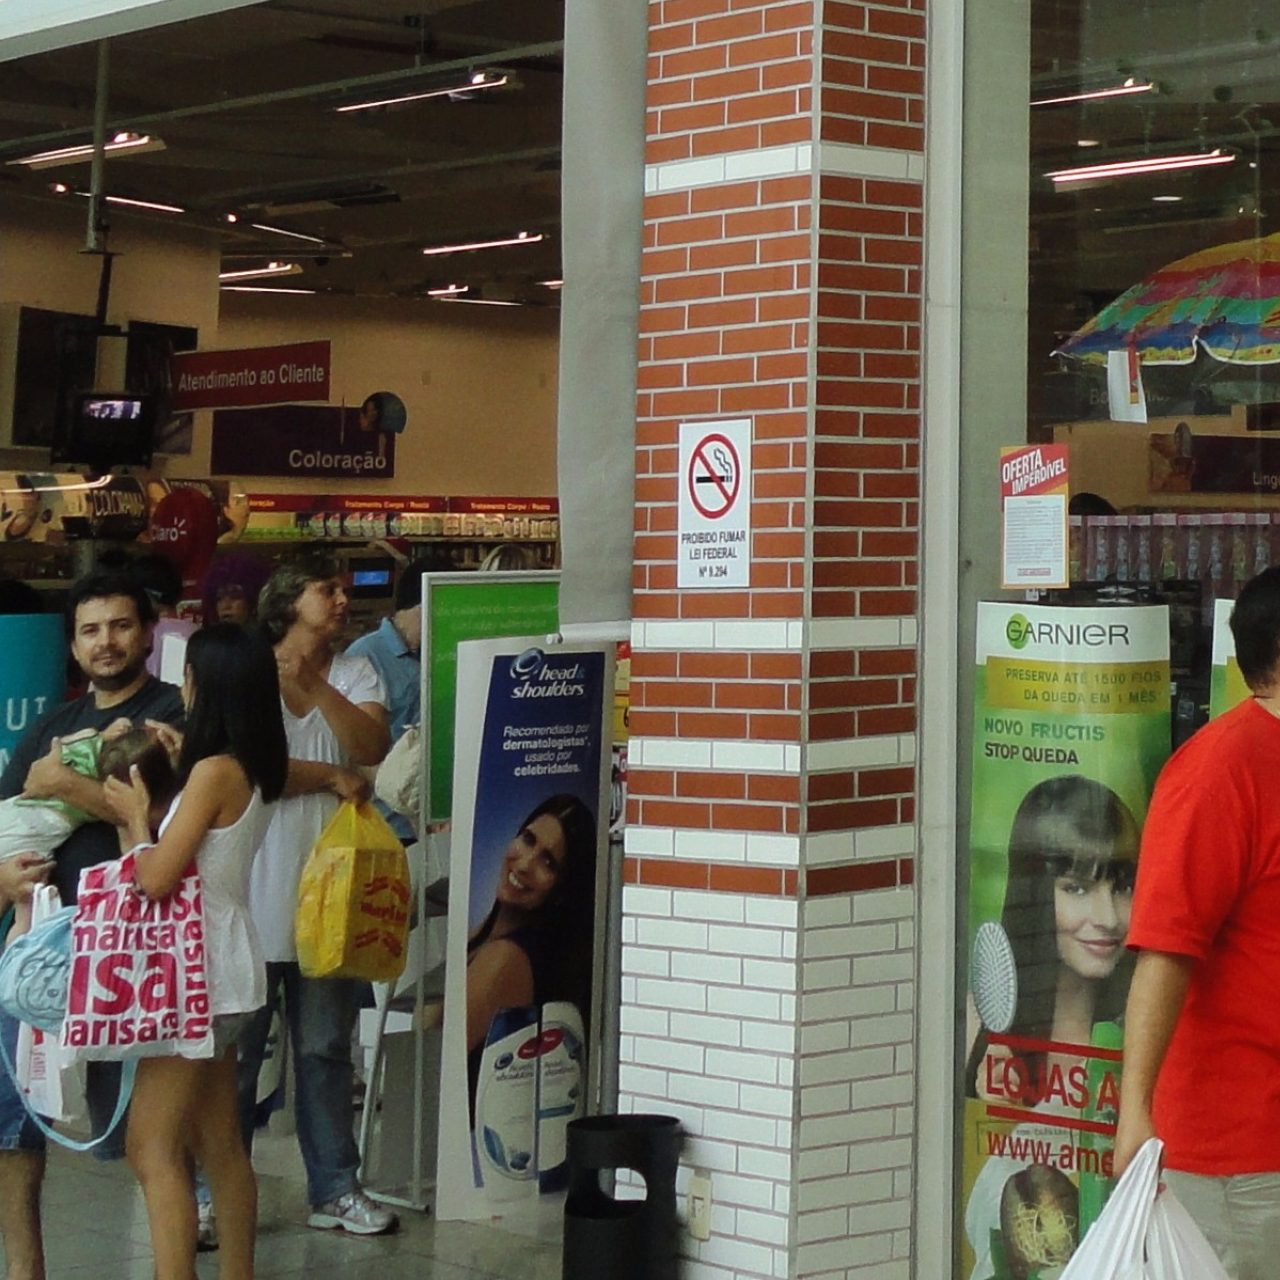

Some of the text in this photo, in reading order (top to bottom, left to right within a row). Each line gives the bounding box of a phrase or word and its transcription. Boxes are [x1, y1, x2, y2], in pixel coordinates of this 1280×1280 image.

[178, 363, 325, 392] Atendimento ao Cliente
[289, 449, 387, 474] Coloração
[1002, 448, 1043, 484] OFERTA
[1012, 457, 1067, 496] IMPERDÍVEL
[681, 530, 746, 544] PROIBIDO FUMAR
[690, 547, 738, 560] LEI FEDERAL
[1006, 620, 1130, 647] GARNIER
[538, 663, 579, 681] head
[1005, 667, 1059, 683] PRESERVA
[1094, 673, 1126, 685] 1500
[511, 681, 584, 699] shoulders
[1024, 688, 1038, 702] DA
[1042, 690, 1085, 703] QUEDA
[1090, 691, 1110, 704] EM
[503, 723, 574, 738] Recomendado
[985, 717, 1106, 742] NOVO FRUCTIS
[524, 750, 573, 763] usado por
[985, 742, 1080, 765] STOP QUEDA
[63, 1016, 159, 1047] arisa
[986, 1053, 1090, 1109] LOJAS
[987, 1131, 1115, 1178] www.ame
